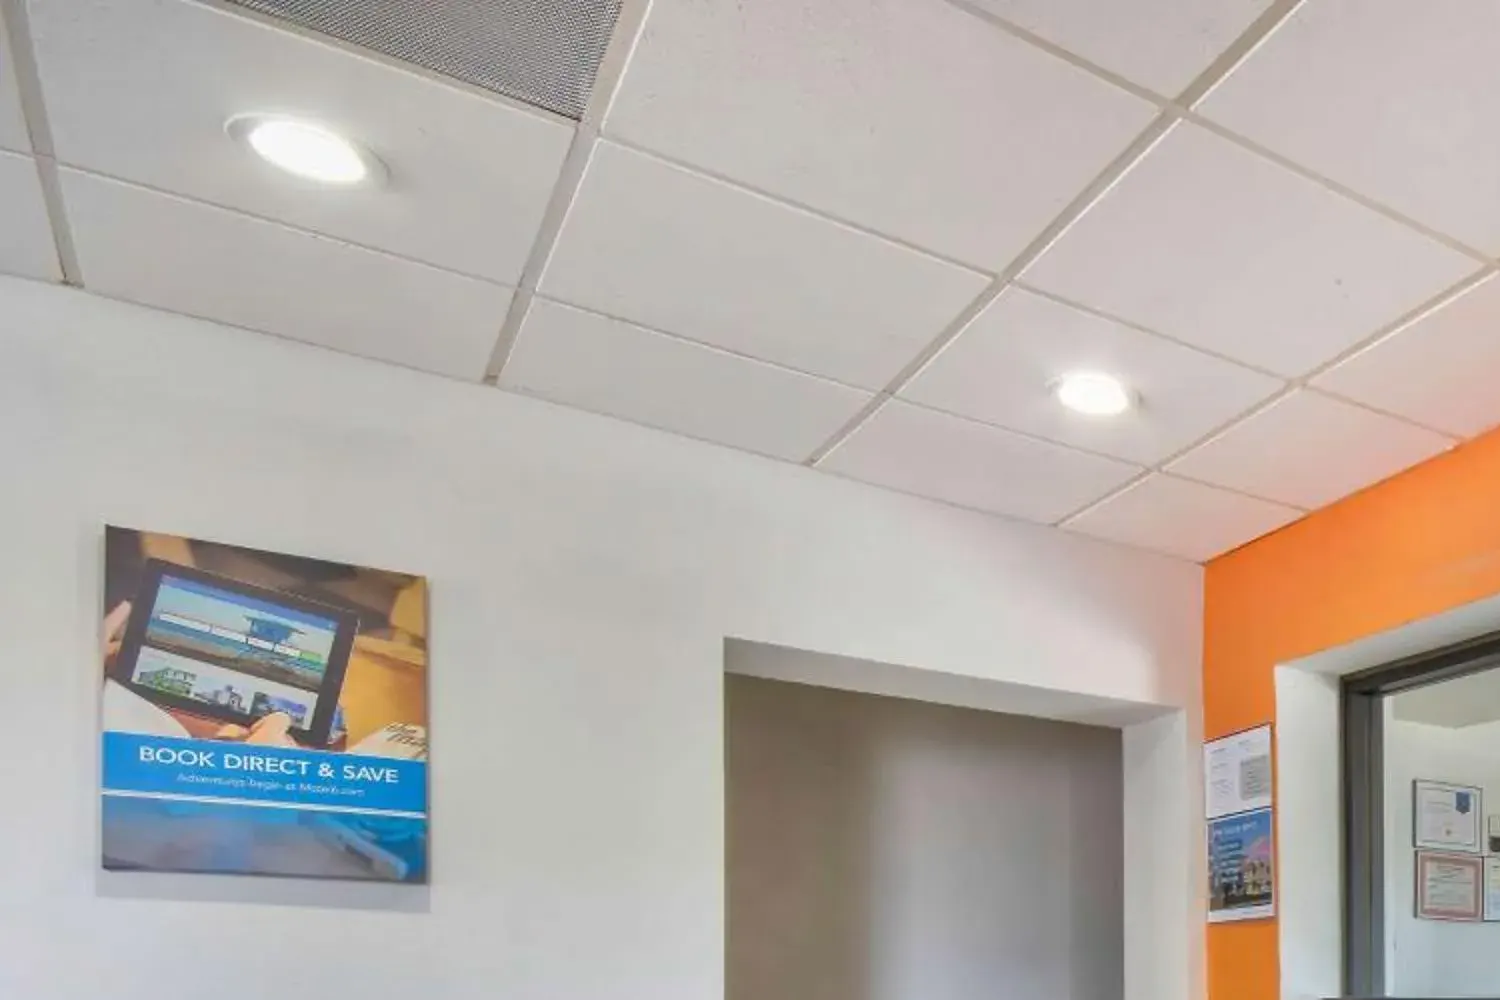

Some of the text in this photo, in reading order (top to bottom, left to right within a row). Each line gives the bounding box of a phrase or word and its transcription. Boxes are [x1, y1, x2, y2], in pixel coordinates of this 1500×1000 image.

[139, 746, 399, 783] BOOK DIRECT & SAVE
